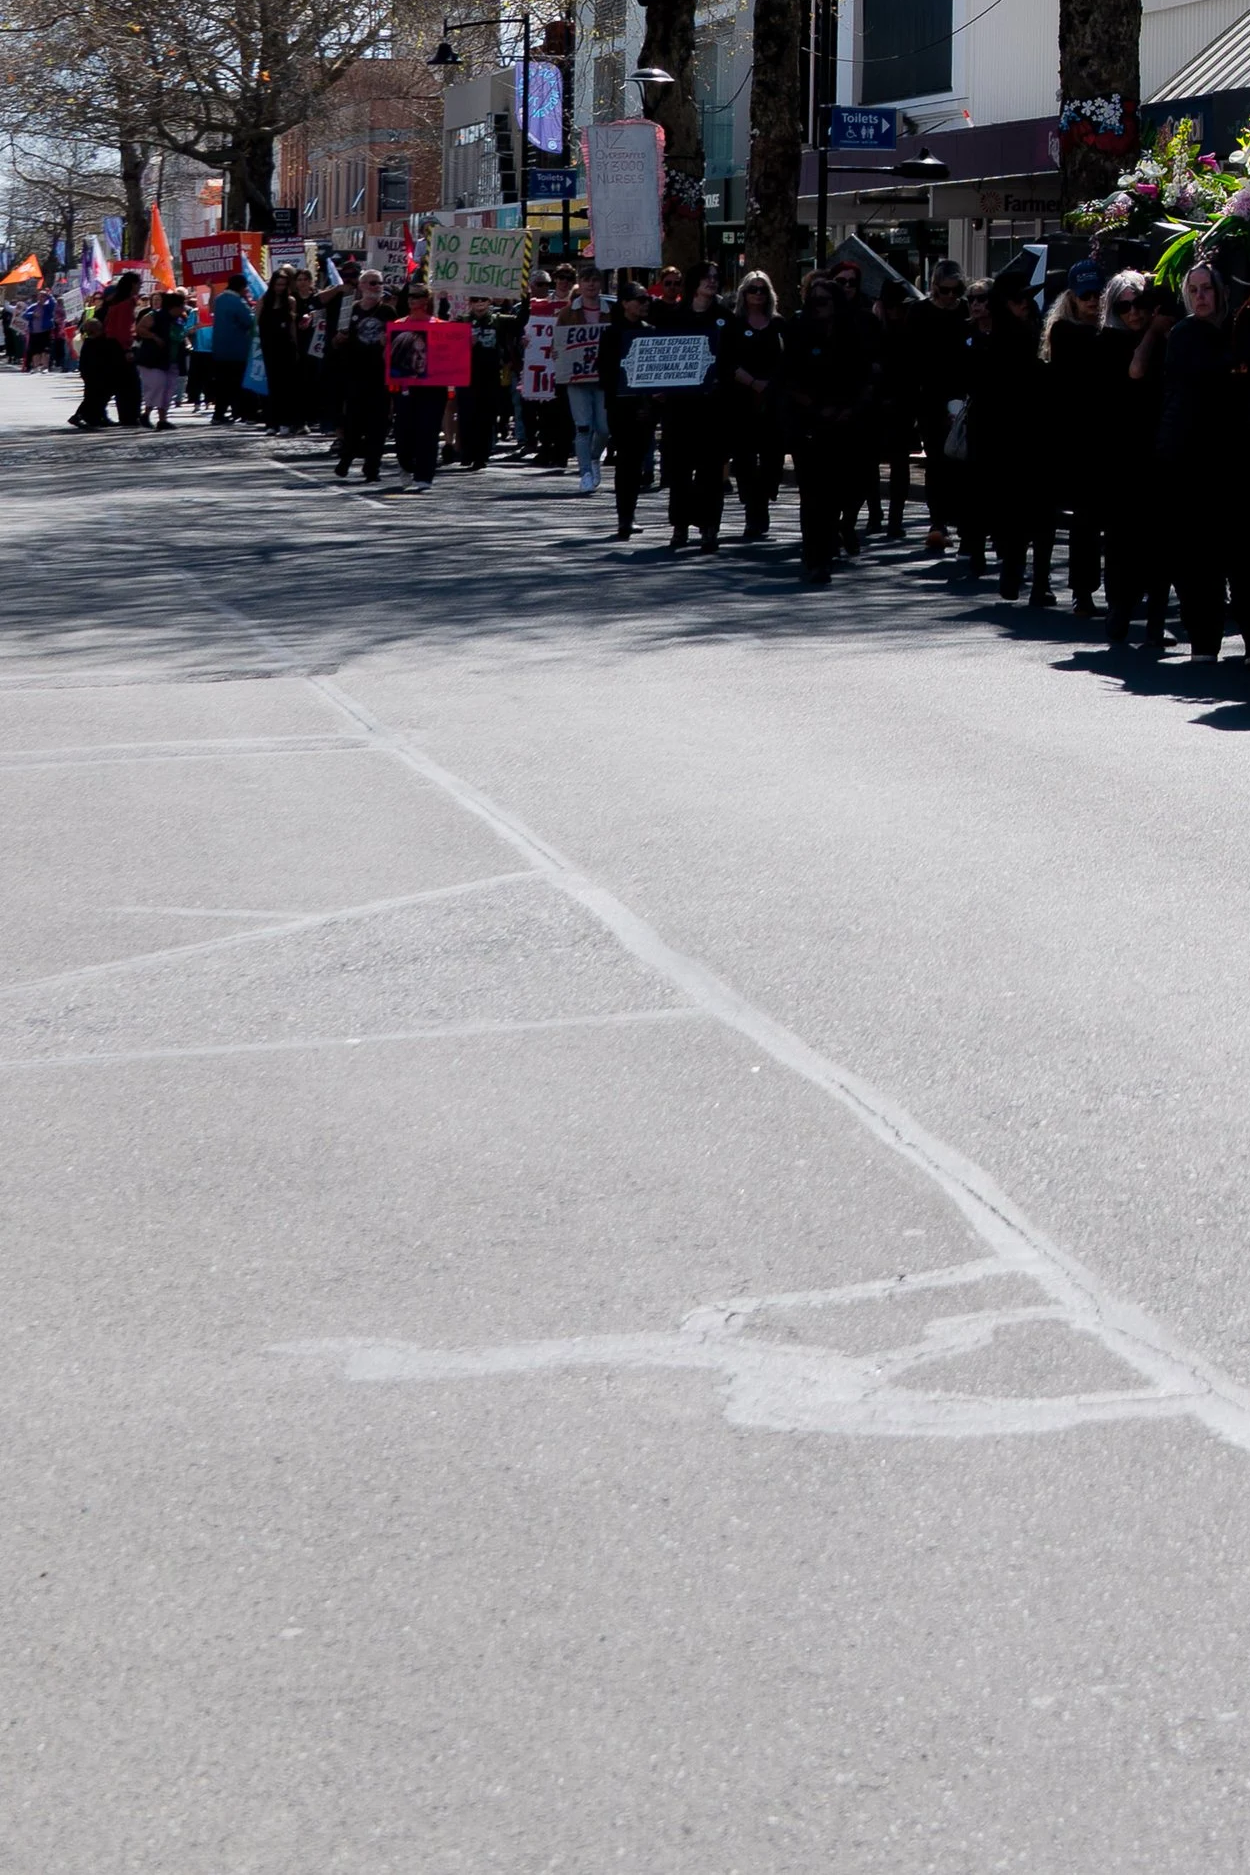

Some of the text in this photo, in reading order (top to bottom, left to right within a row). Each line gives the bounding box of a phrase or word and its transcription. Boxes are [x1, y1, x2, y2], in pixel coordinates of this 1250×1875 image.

[841, 112, 879, 124] Toilets
[595, 129, 626, 150] NZ
[596, 161, 609, 172] BY
[535, 173, 564, 182] Toilets
[597, 174, 645, 185] NURSES
[222, 242, 239, 258] ARE
[437, 235, 524, 260] NO EQUITY
[435, 261, 522, 291] NO JUSTICE
[640, 338, 650, 346] ALL
[639, 347, 671, 355] WHETHER
[672, 346, 680, 354] OF
[637, 363, 644, 372] IS
[683, 361, 698, 371] AND
[636, 373, 653, 381] MUST
[654, 372, 662, 380] BE
